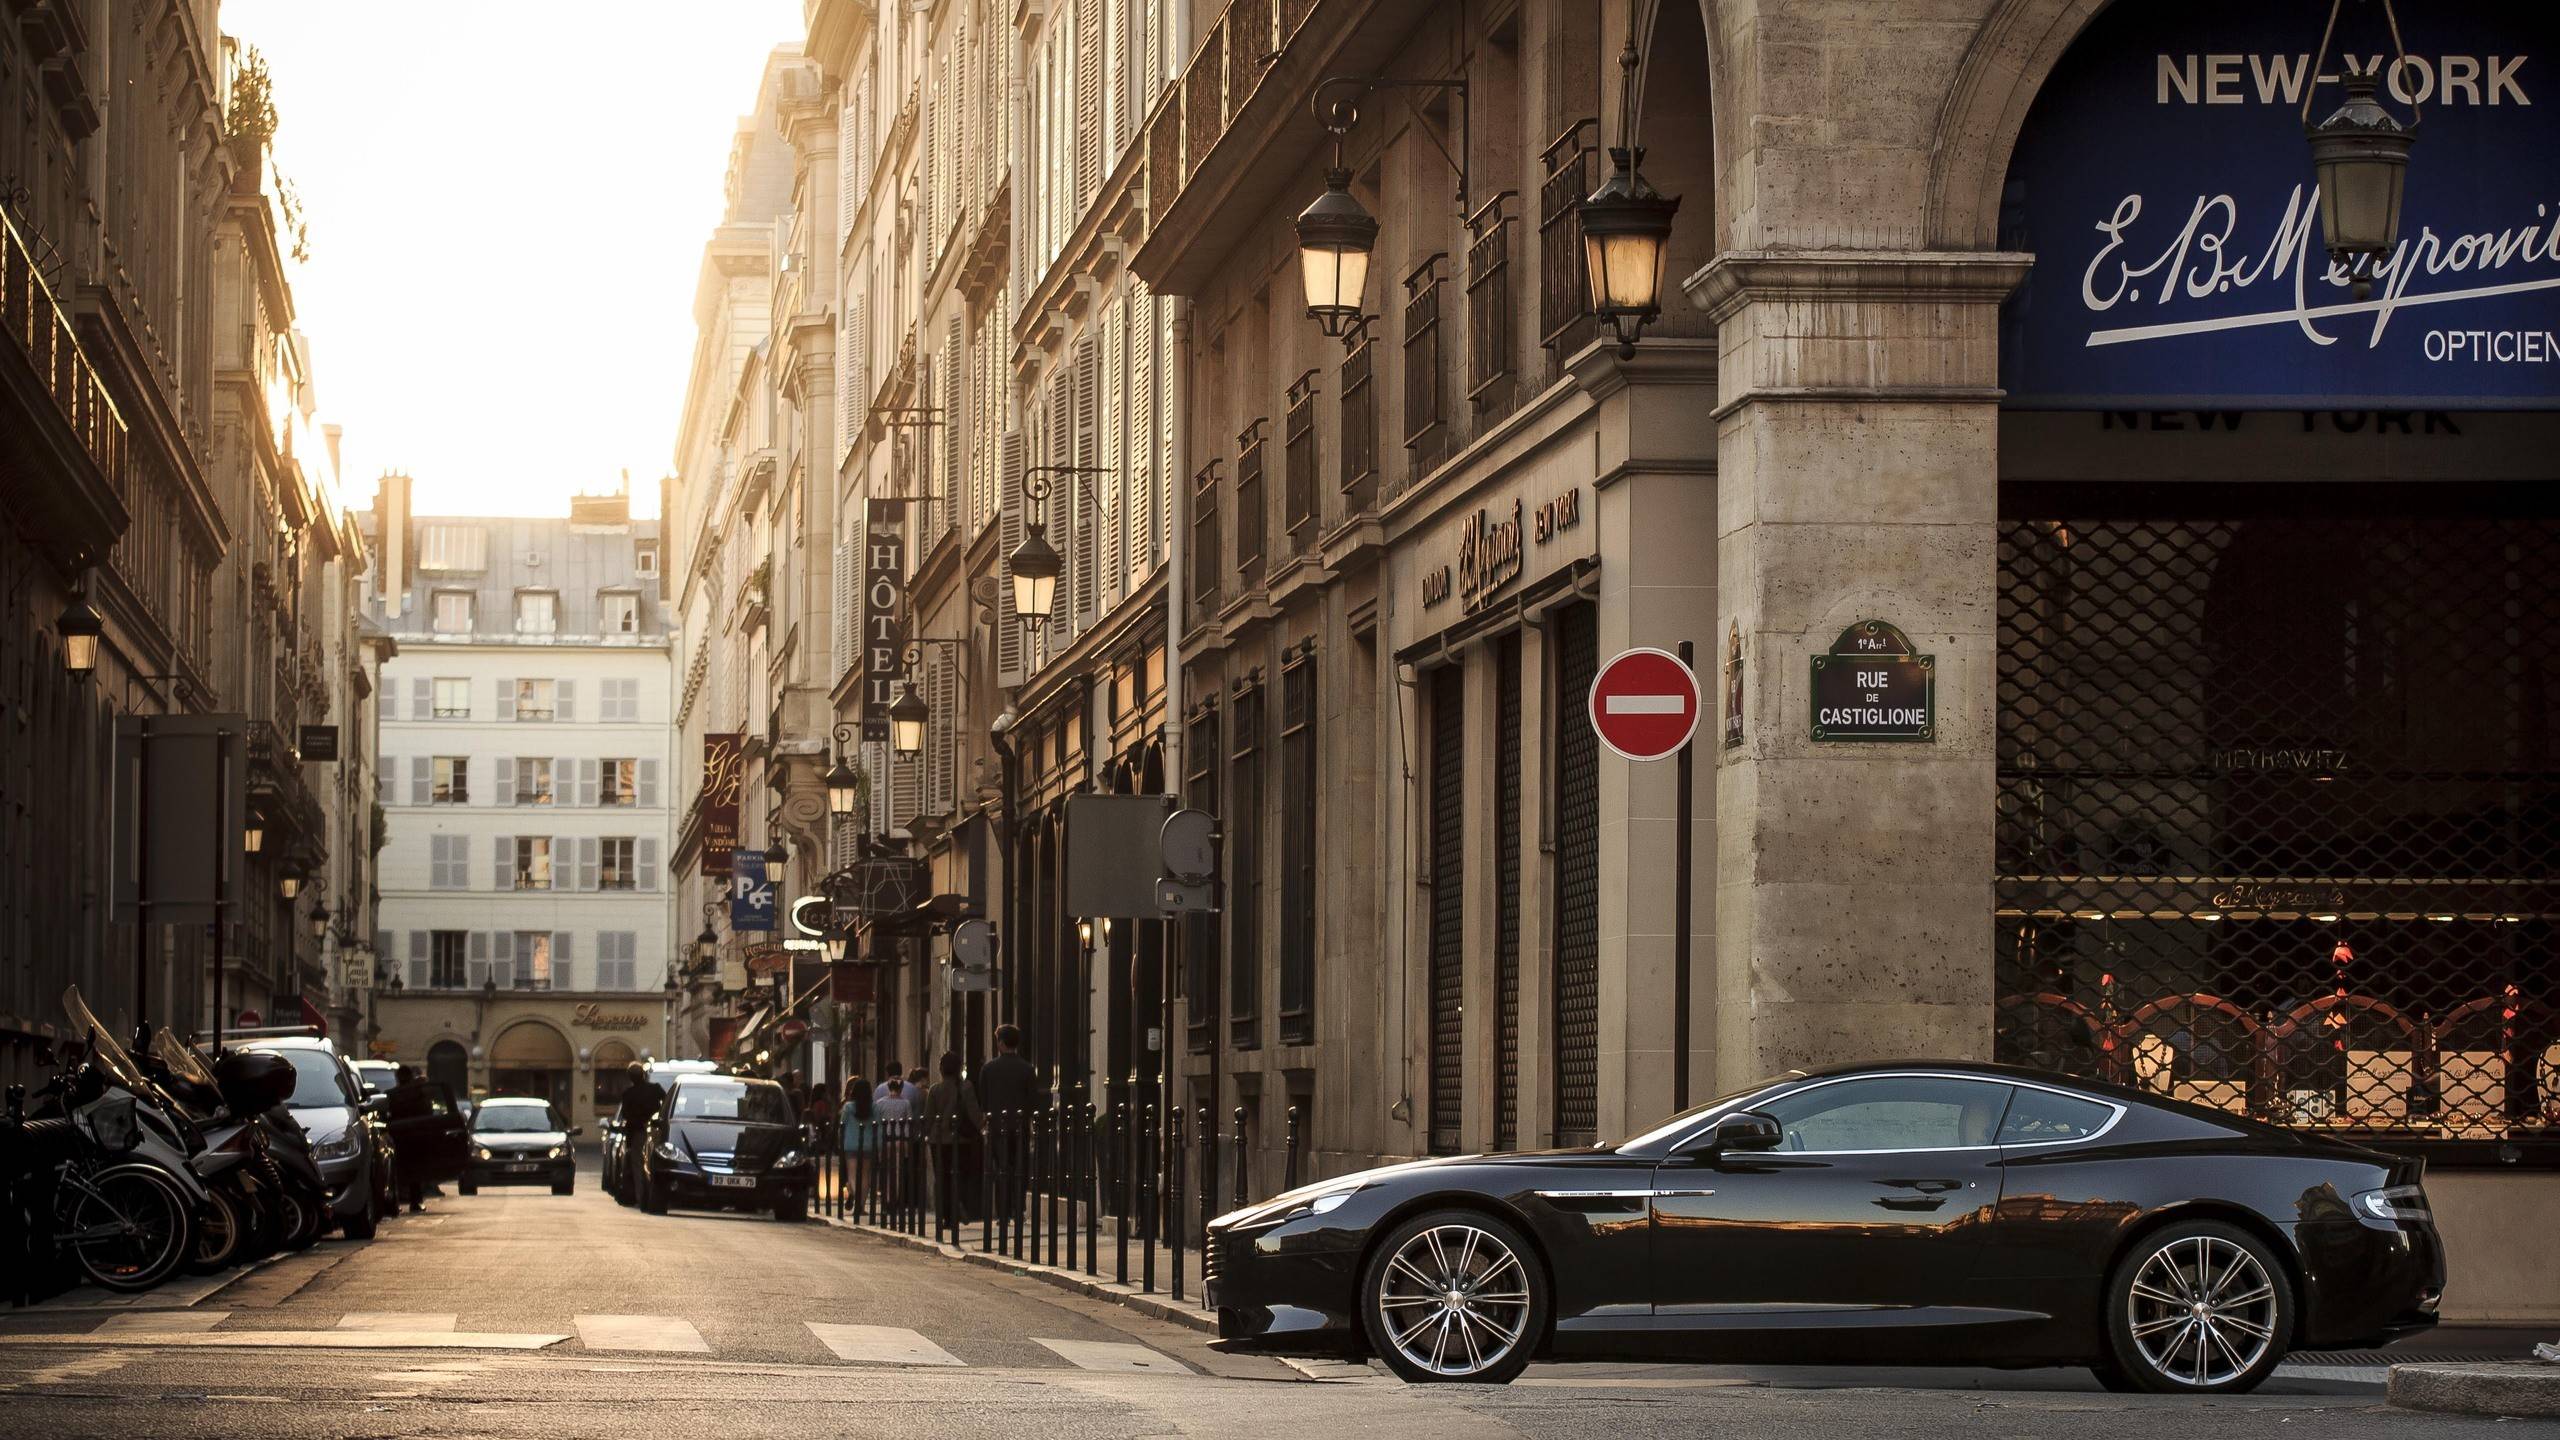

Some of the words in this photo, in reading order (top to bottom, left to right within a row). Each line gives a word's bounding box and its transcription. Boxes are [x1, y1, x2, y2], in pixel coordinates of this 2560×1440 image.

[1856, 671, 1889, 688] RUE
[1865, 693, 1879, 703] DE
[1819, 708, 1926, 725] CASTIGLIONE
